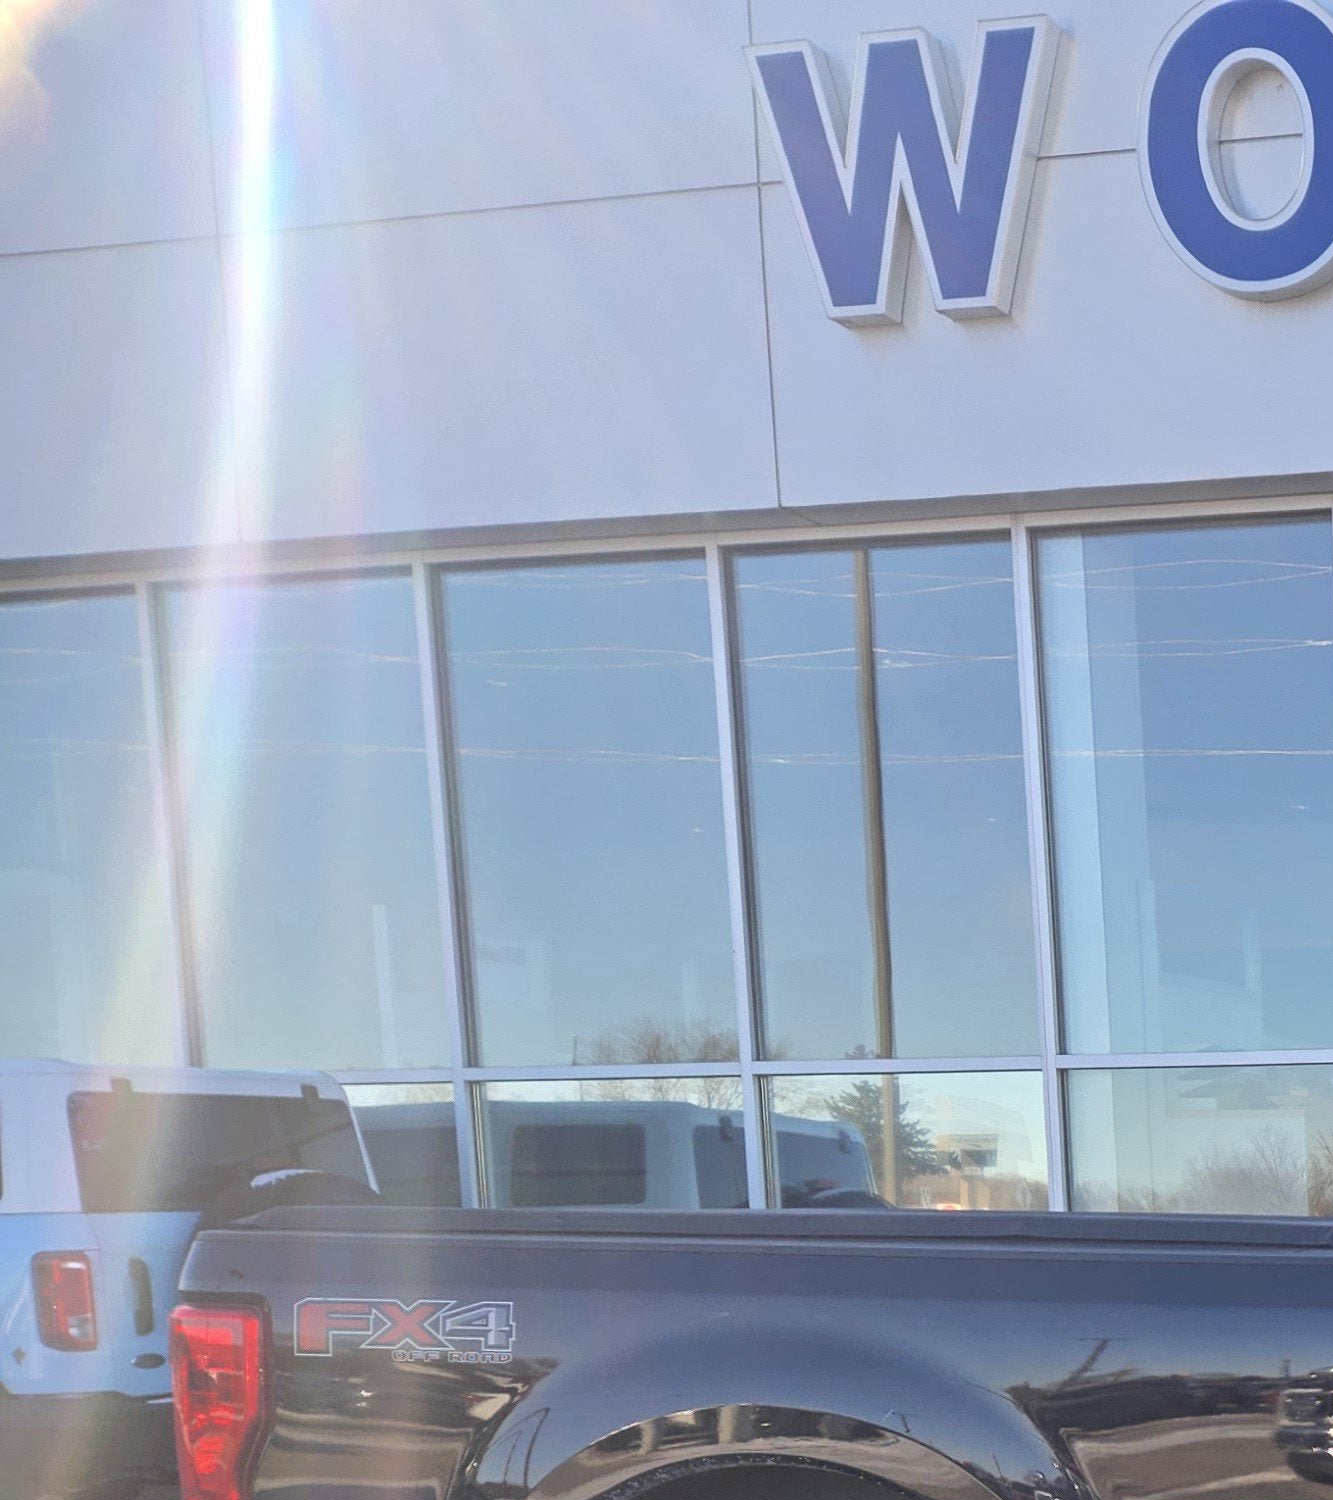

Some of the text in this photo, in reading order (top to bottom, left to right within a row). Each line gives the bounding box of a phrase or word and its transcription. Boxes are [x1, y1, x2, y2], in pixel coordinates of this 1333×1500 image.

[294, 1297, 516, 1357] FX4
[392, 1350, 513, 1363] OFF ROAD
